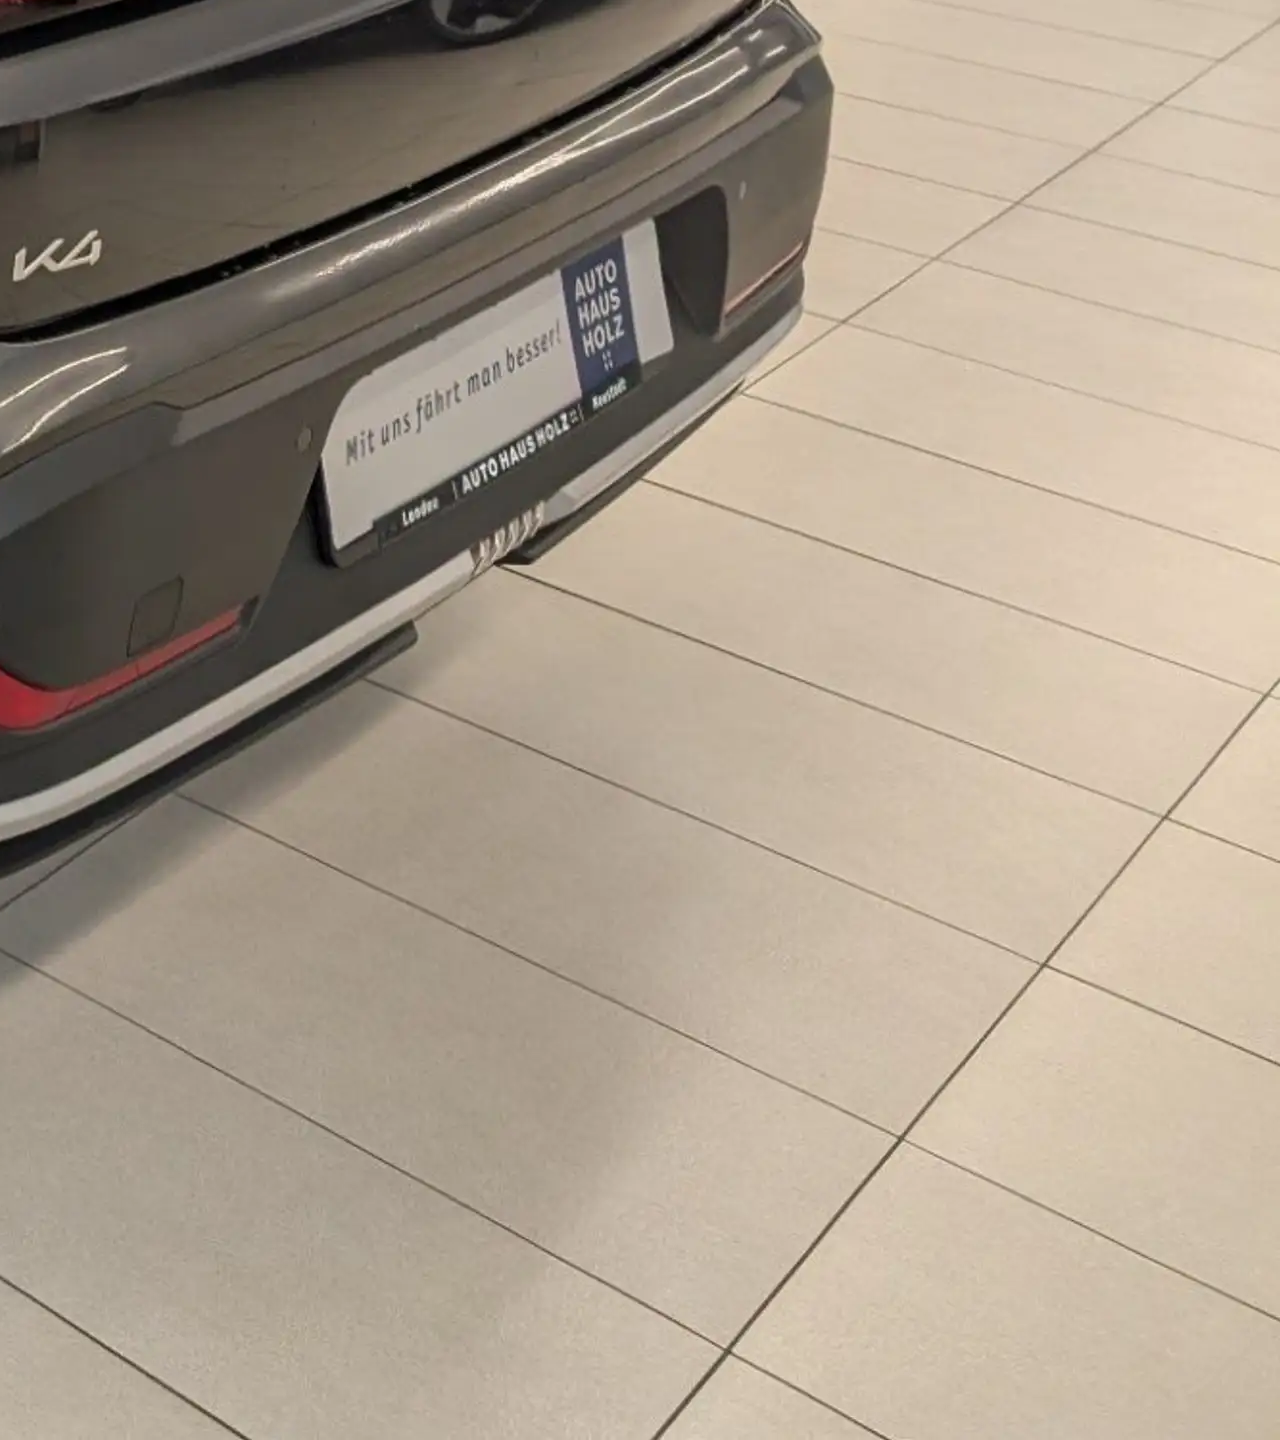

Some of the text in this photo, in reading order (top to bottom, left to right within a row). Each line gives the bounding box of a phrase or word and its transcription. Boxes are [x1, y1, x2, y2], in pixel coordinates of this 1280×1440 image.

[12, 228, 102, 281] K4
[574, 258, 617, 302] AUTO
[577, 287, 621, 329] HAUS
[581, 313, 625, 358] HOLZ
[345, 317, 563, 465] Mit uns fährt man besser!
[461, 412, 570, 495] AUTO HAUS HOLZ
